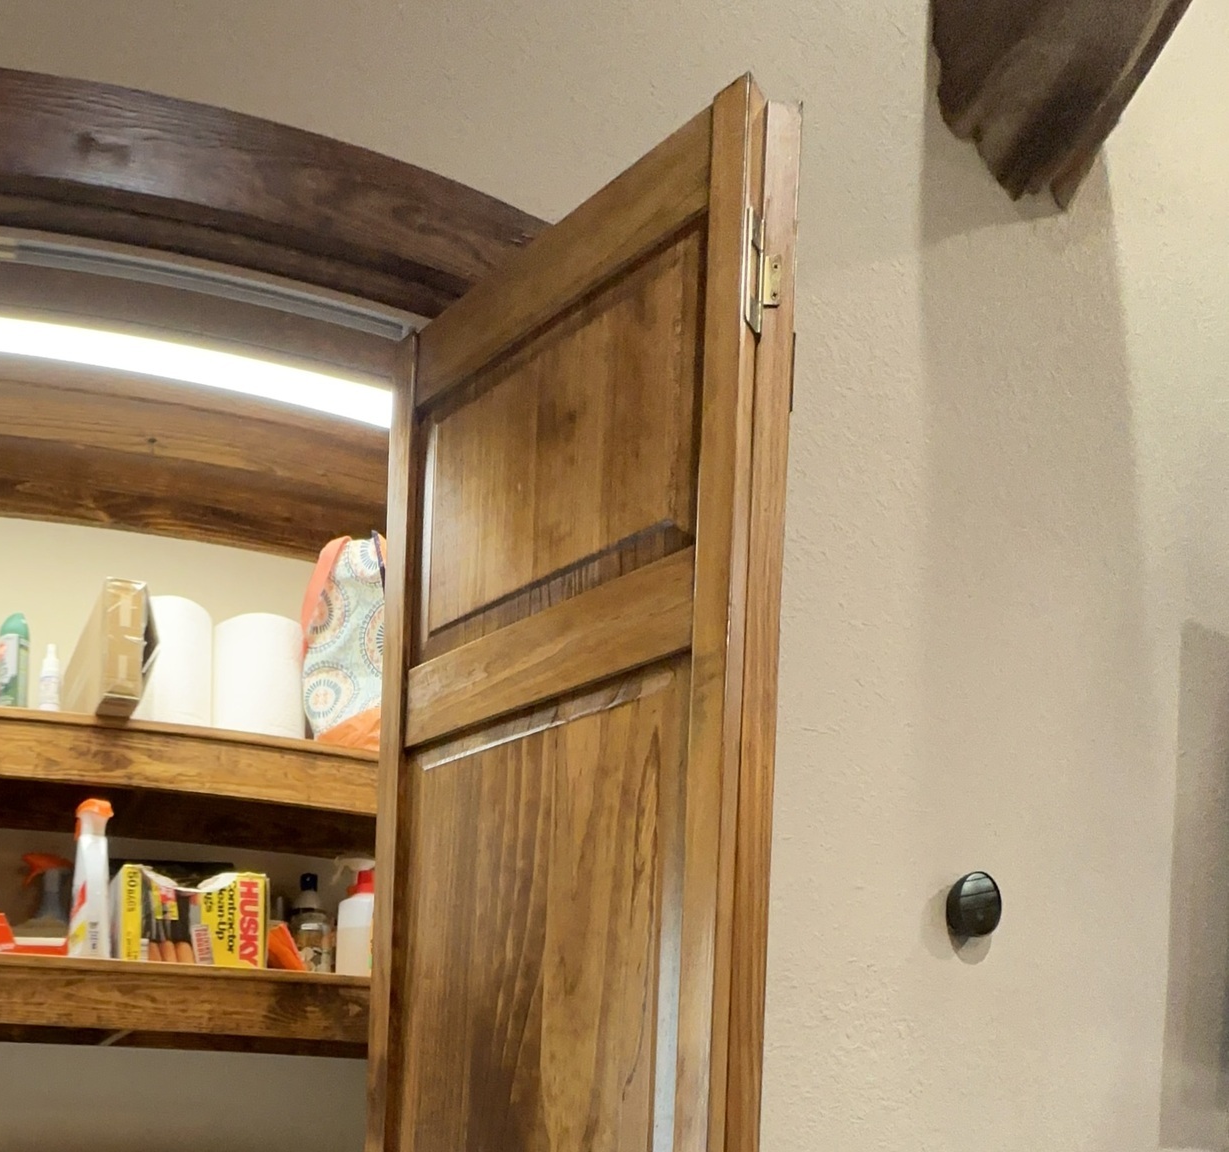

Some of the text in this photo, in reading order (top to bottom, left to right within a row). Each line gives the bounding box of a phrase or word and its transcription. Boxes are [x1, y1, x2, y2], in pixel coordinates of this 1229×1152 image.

[216, 888, 227, 940] lean-Up
[226, 880, 237, 954] Contractor
[239, 880, 259, 966] HUSKY
